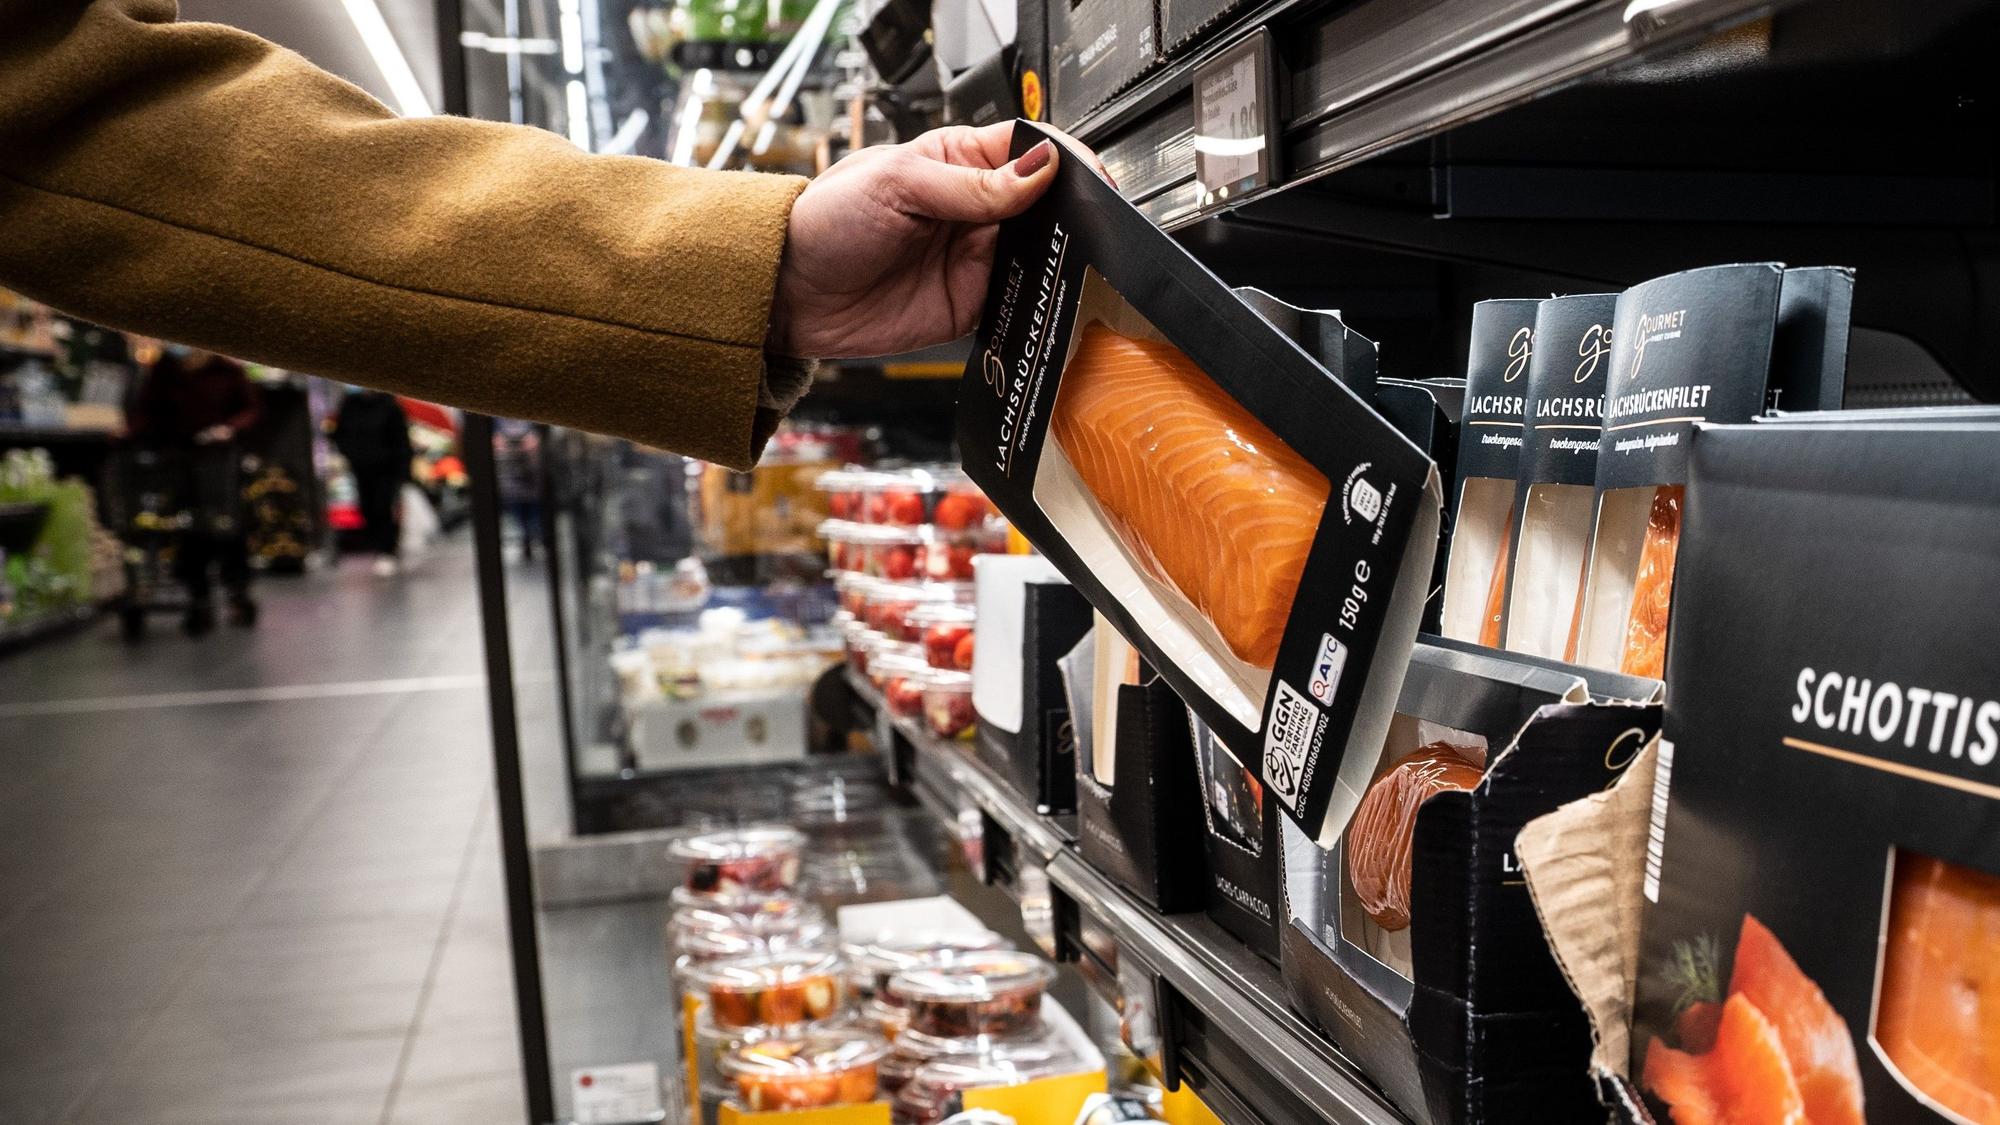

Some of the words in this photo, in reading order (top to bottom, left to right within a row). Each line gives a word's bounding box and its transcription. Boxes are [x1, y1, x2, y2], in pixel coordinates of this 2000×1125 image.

[996, 222, 1064, 472] LACHSRÜCKENFILET
[1609, 385, 1711, 419] LACHSRÜCKENFILET
[1338, 597, 1360, 631] 150
[1351, 584, 1368, 603] g
[1272, 689, 1294, 743] GGN
[1283, 700, 1301, 751] CERTIFIED
[1290, 706, 1309, 757] FARMING
[1792, 667, 2000, 766] SCHOTTIS
[1302, 713, 1330, 794] 4056186627902
